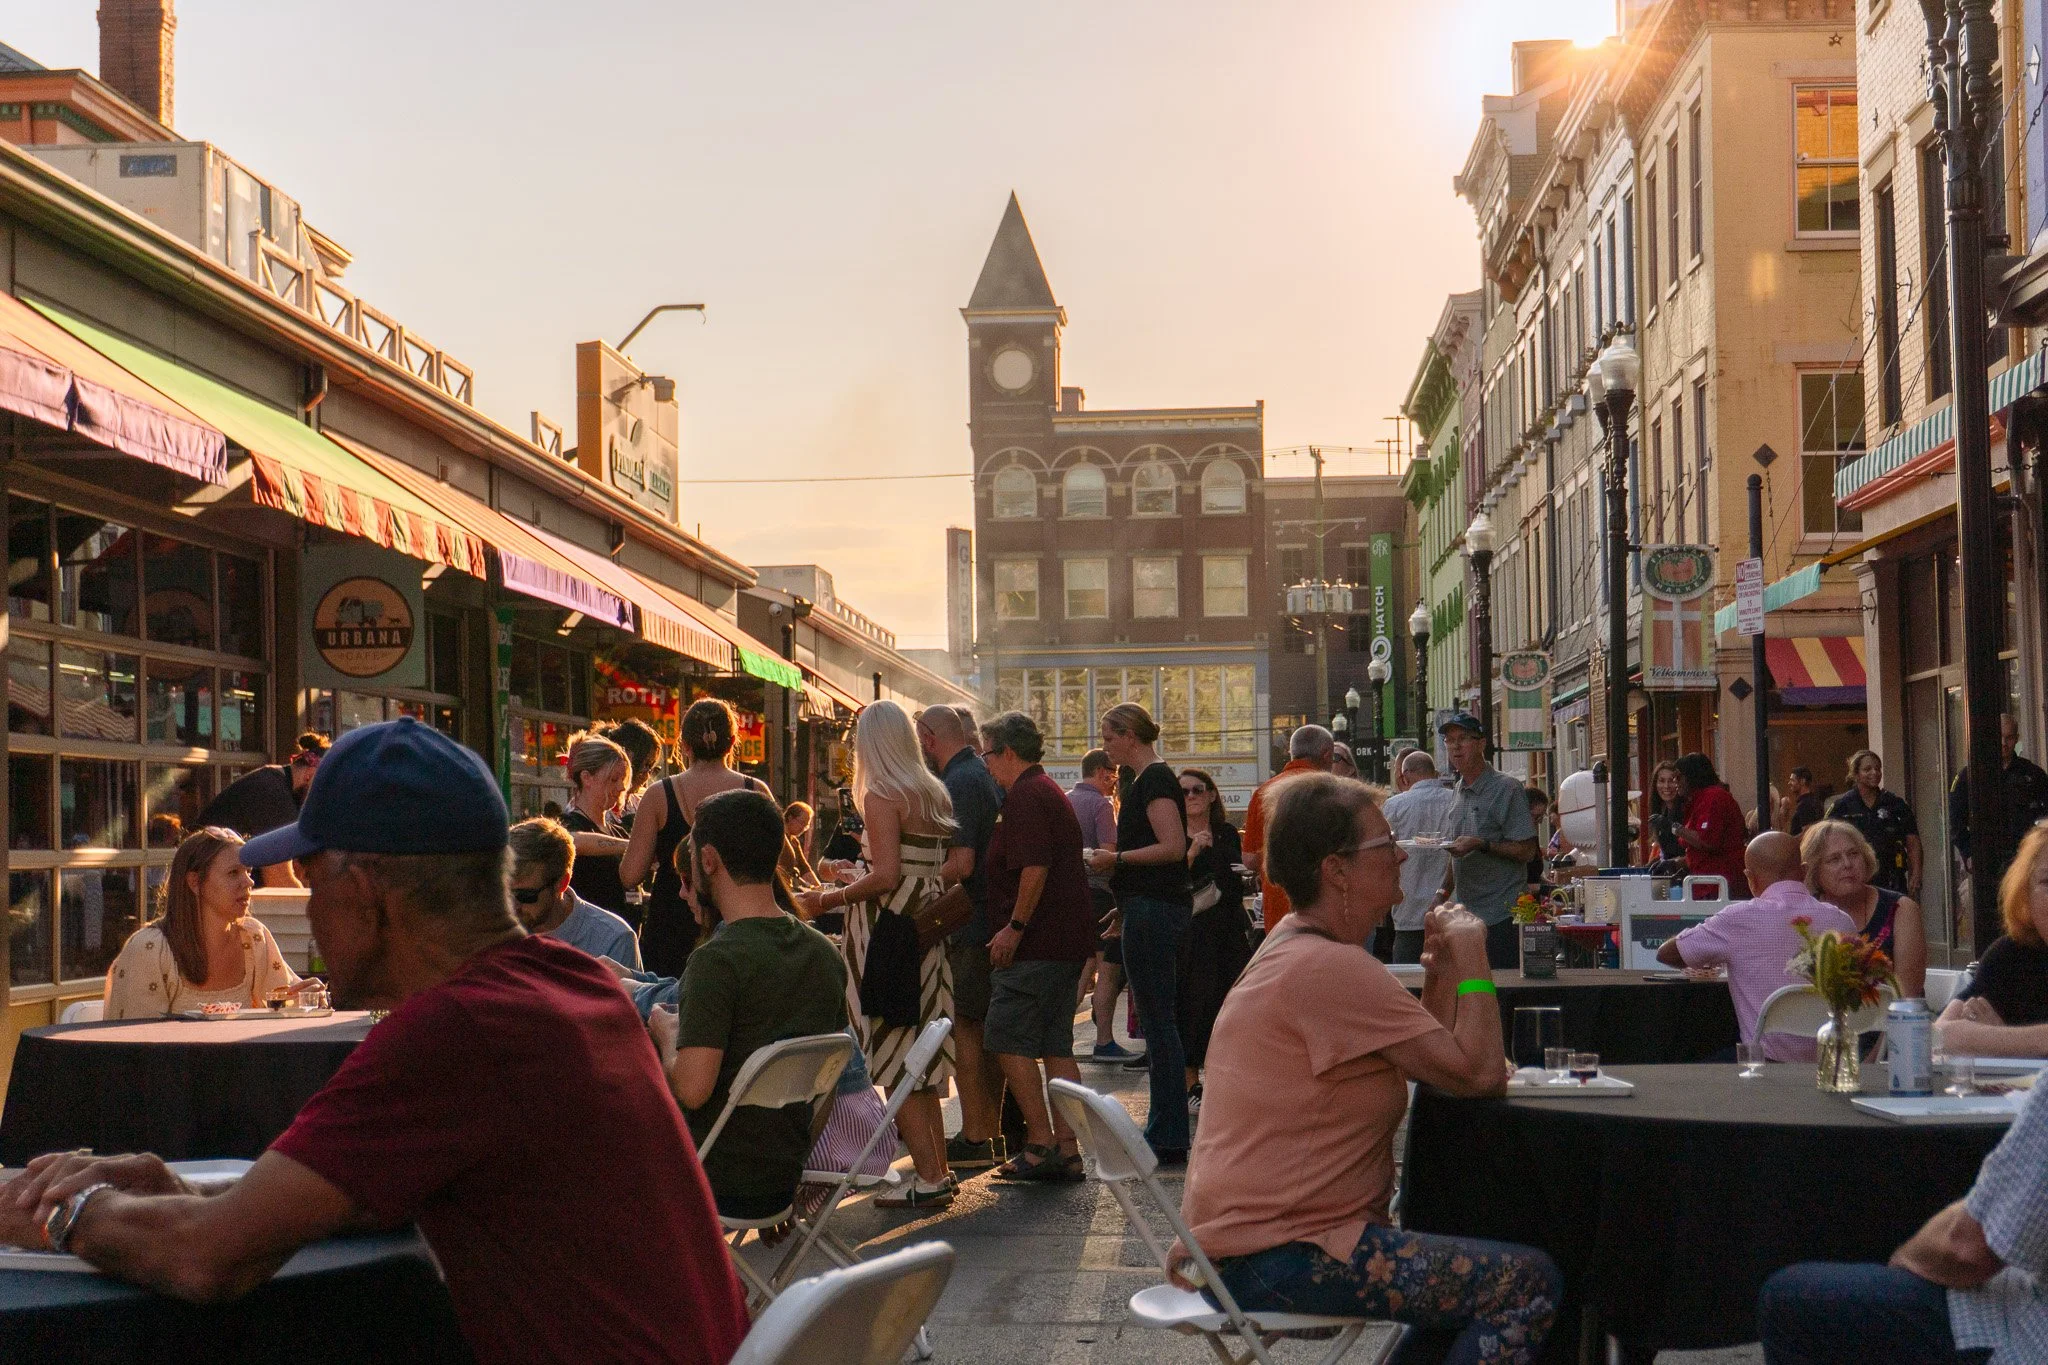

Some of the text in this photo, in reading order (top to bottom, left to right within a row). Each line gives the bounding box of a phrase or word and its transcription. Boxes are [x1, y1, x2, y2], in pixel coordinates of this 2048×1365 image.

[1375, 585, 1384, 634] HATCH
[328, 630, 401, 646] URBANA
[607, 687, 665, 705] ROTH
